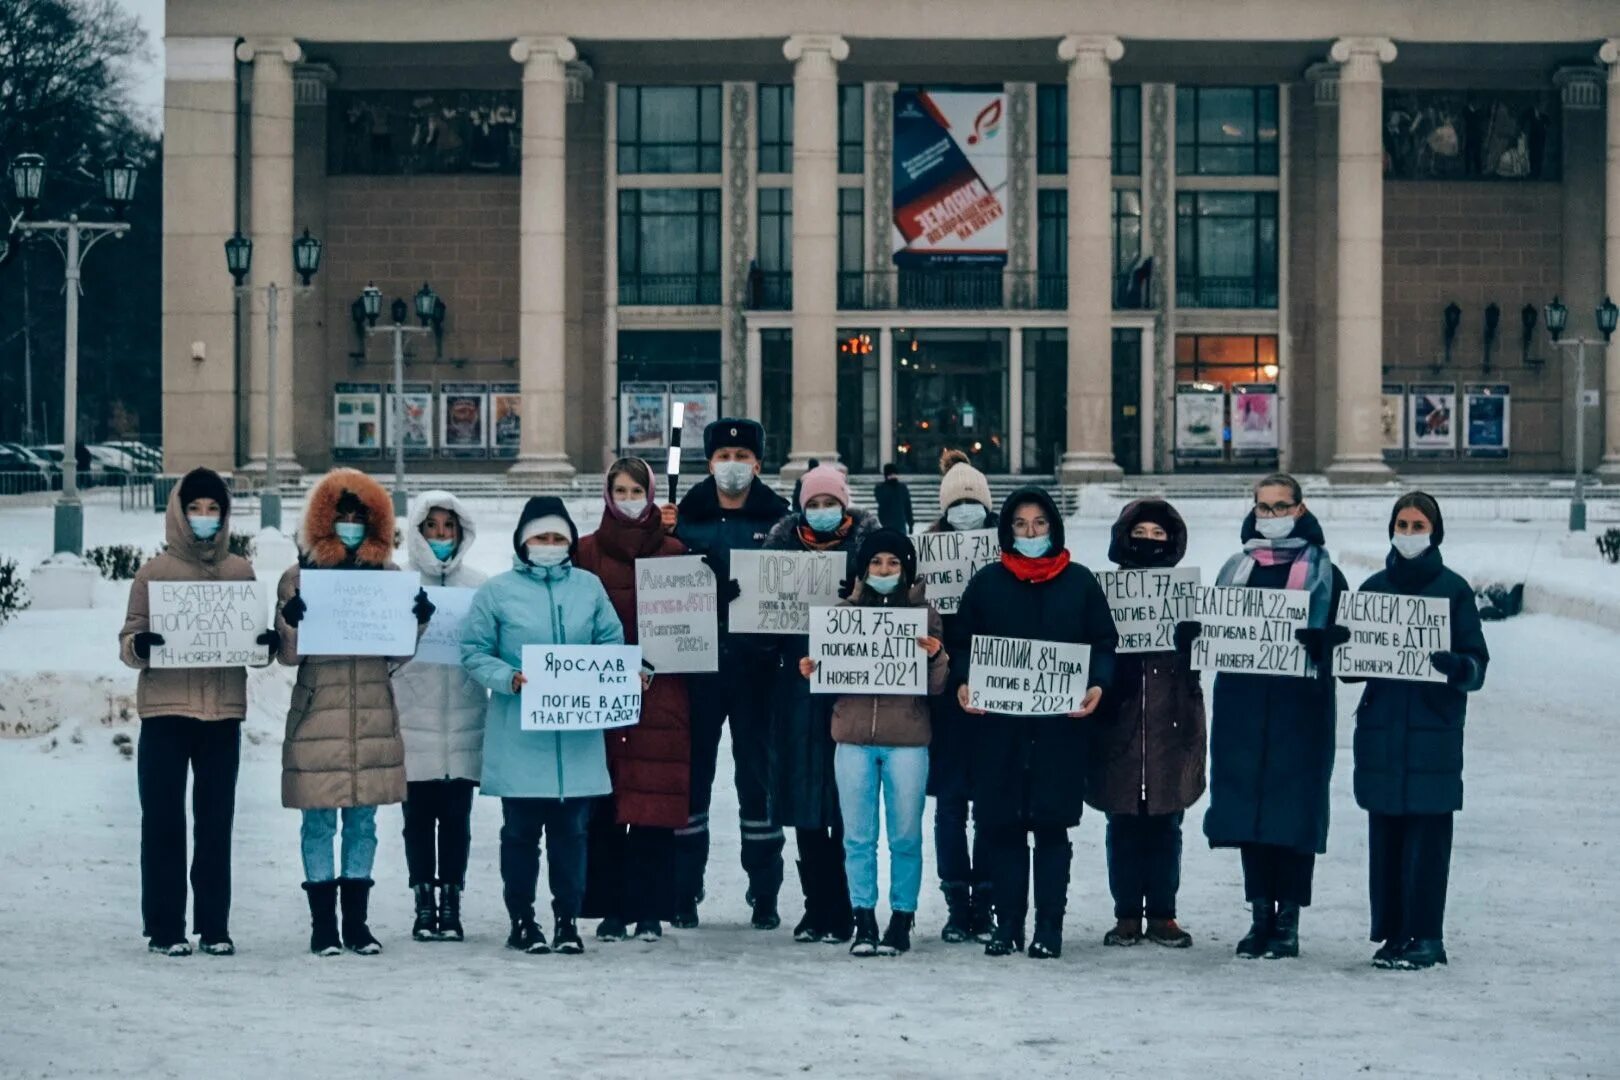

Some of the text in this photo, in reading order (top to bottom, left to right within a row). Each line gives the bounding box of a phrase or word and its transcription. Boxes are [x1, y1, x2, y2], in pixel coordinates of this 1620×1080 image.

[911, 533, 968, 562] ИКТОР.
[971, 535, 990, 558] 79
[758, 554, 832, 596] ЮРИЙ
[956, 568, 964, 583] В
[1152, 574, 1171, 597] 77
[1172, 582, 1195, 596] ЛЕТ
[162, 584, 257, 602] ЕКАТЕРИНА
[178, 601, 238, 614] 22 ГОДА
[1149, 605, 1157, 620] В
[1267, 593, 1286, 619] 22
[1286, 607, 1307, 620] ГОДА
[1406, 598, 1426, 626] 20
[1426, 614, 1447, 627] ЛЕТ
[151, 611, 256, 631] ПОГИБЛА В
[872, 611, 895, 636] 75
[896, 623, 919, 637] ЛЕТ
[1203, 620, 1292, 643] ПОГИБЛА В ДТП
[189, 631, 228, 648] ДТП
[821, 636, 916, 660] ПОГИБЛА В ДТП
[1354, 626, 1442, 650] ПОГИБ В ДТП
[156, 647, 174, 666] 14
[1037, 645, 1057, 672] 84
[1058, 660, 1083, 675] ГОДА
[1193, 640, 1300, 672] 14 НОЯБРЯ 2021
[1335, 646, 1352, 672] 15
[1354, 659, 1393, 674] НОЯБРЯ
[826, 670, 870, 685] НОЯБРЯ
[874, 661, 918, 686] 2021
[986, 672, 1071, 695] ПОГИБ В ДТП
[542, 693, 640, 710] ПОГИБ В ДТП
[971, 691, 1074, 713] 8 НОЯБРЯ 2021
